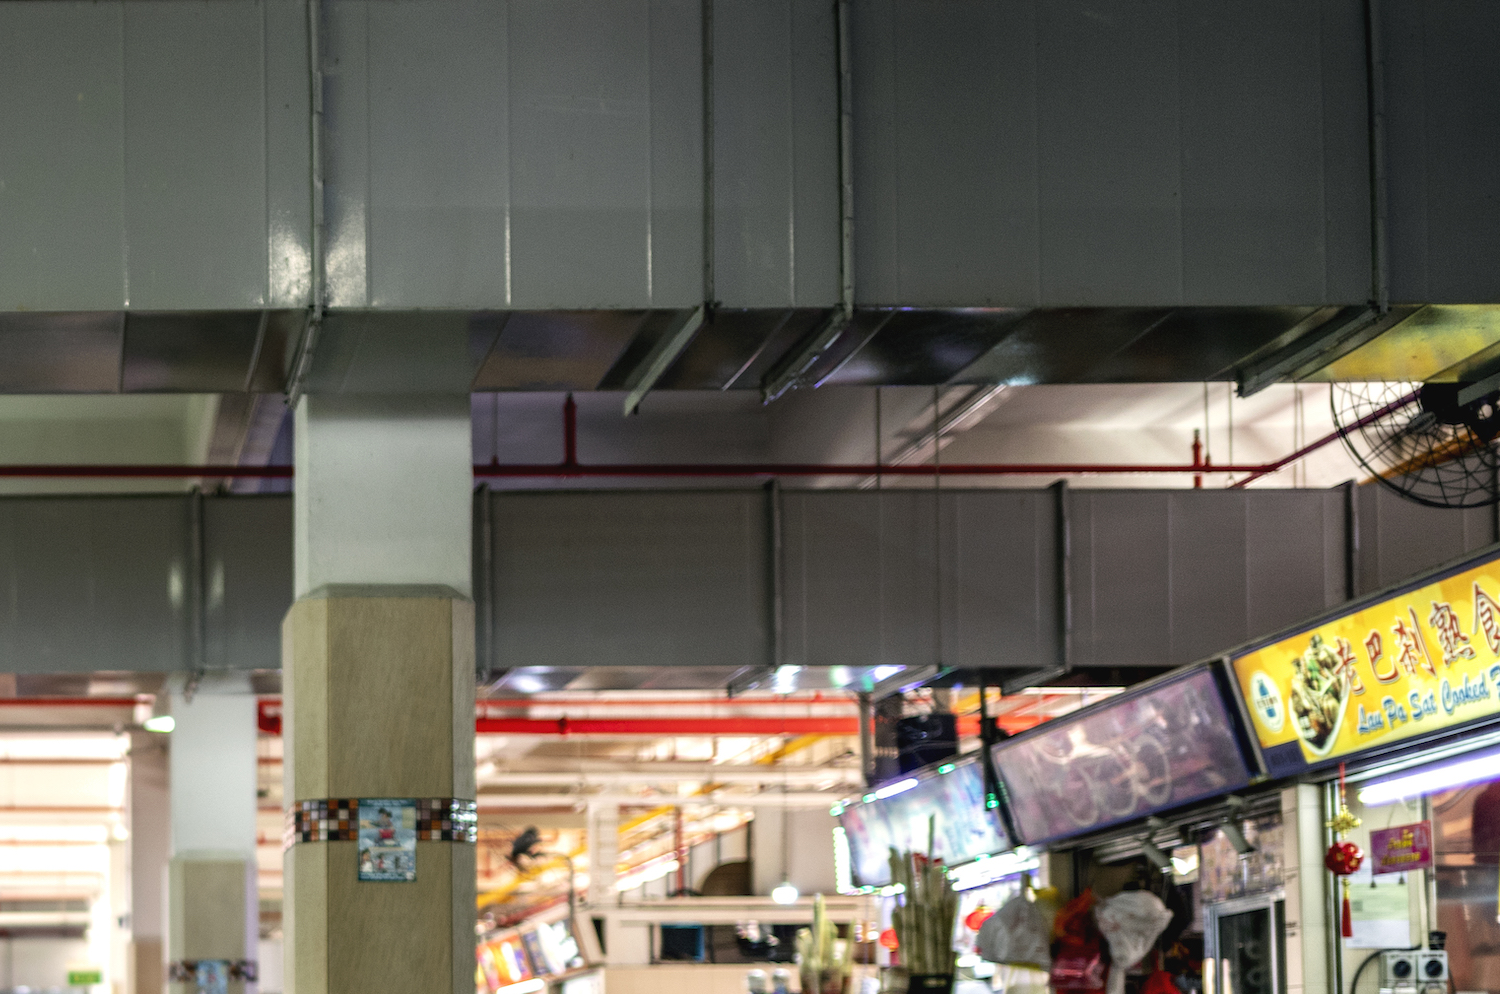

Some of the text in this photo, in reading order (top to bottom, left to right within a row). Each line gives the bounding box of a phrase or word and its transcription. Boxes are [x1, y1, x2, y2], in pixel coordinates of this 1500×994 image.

[1358, 704, 1384, 735] Lau
[1383, 695, 1408, 729] Pa
[1409, 686, 1438, 721] Sat
[1441, 672, 1490, 715] Cooked
